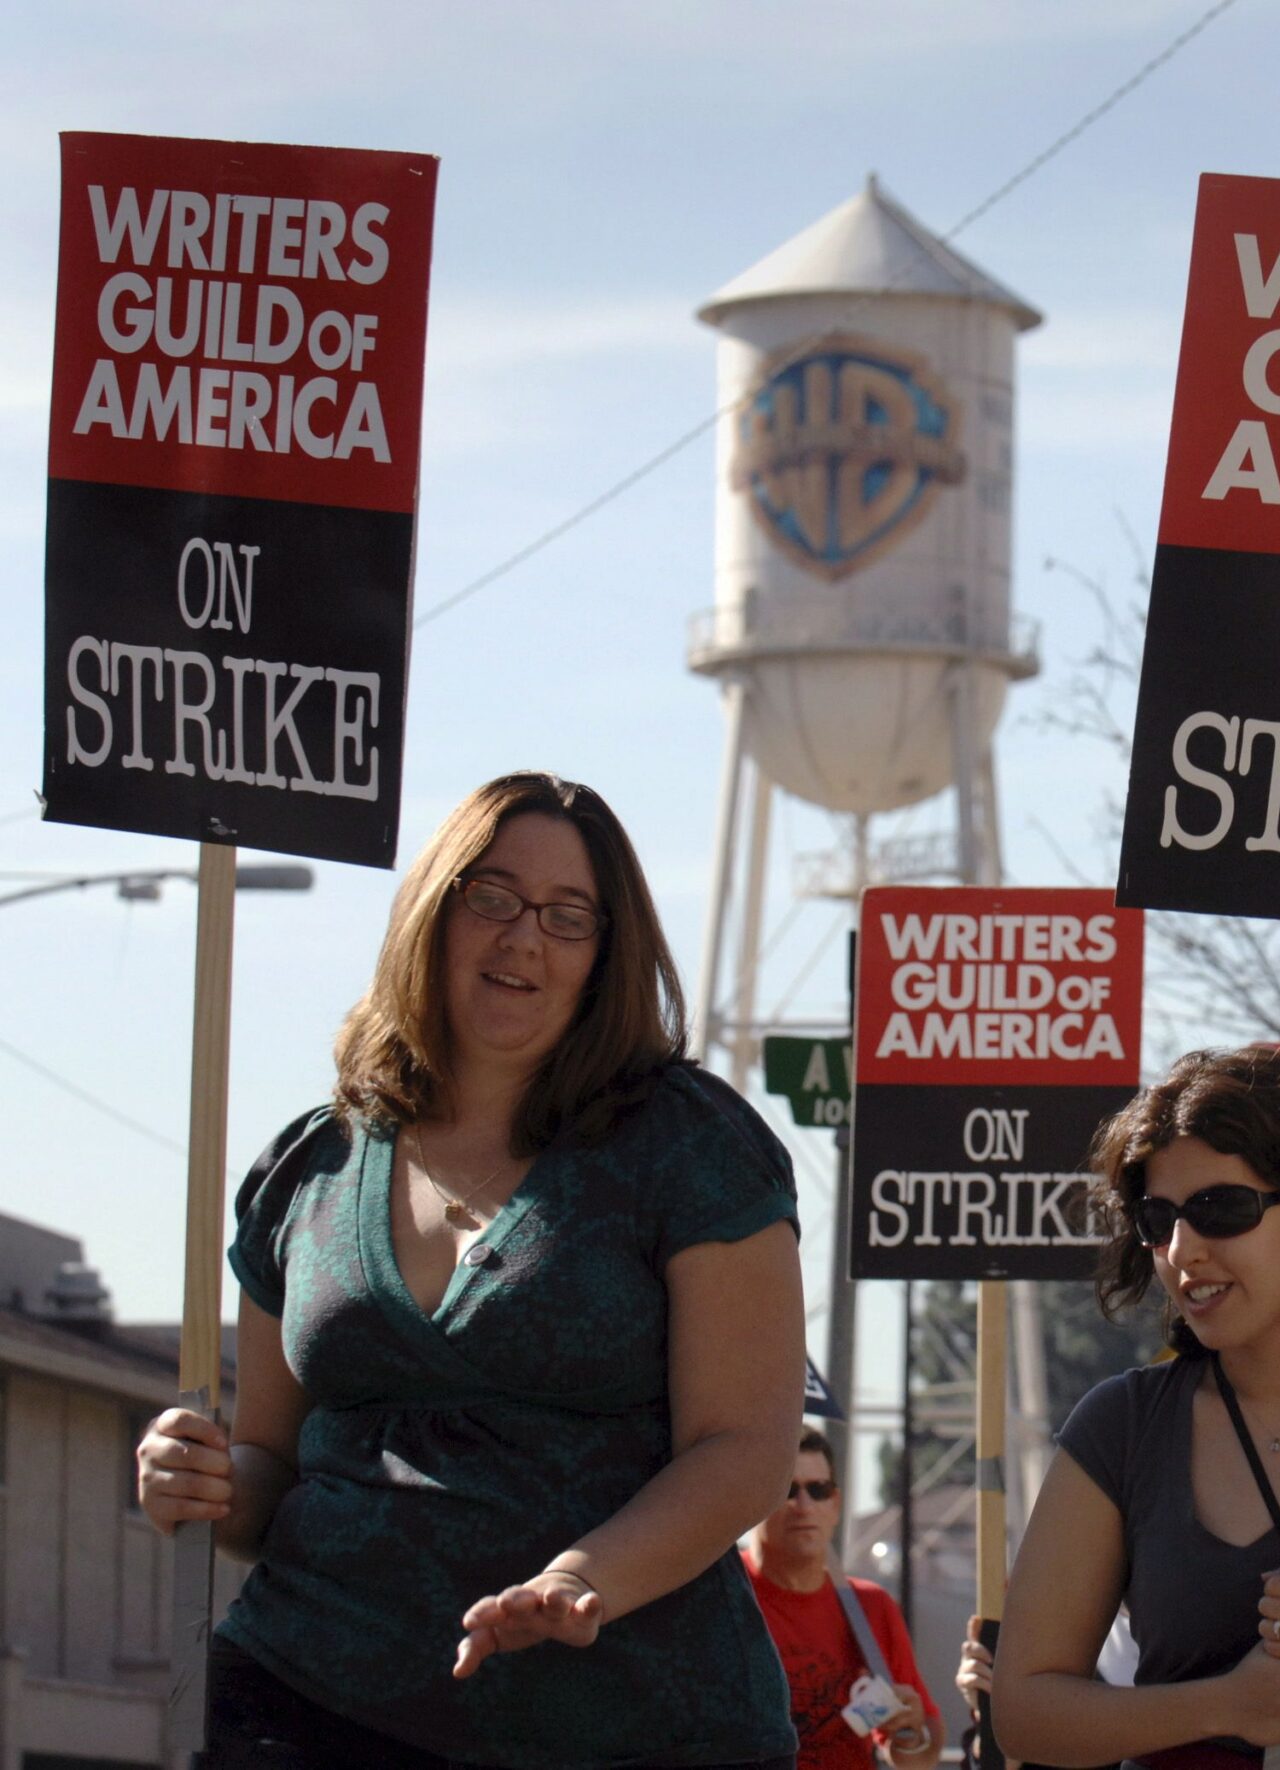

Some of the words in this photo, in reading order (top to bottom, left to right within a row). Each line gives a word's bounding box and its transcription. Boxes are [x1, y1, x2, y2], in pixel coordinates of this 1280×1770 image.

[88, 185, 390, 284] WRITERS
[98, 270, 304, 364] GUILD
[309, 310, 378, 371] OF
[73, 359, 391, 464] AMERICA
[178, 536, 259, 633] ON
[66, 634, 380, 801] STRIKE
[881, 914, 1117, 963] WRITERS
[891, 961, 1055, 1010] GUILD
[1057, 977, 1111, 1011] OF
[876, 1013, 1124, 1059] AMERICA
[963, 1108, 1029, 1162] ON
